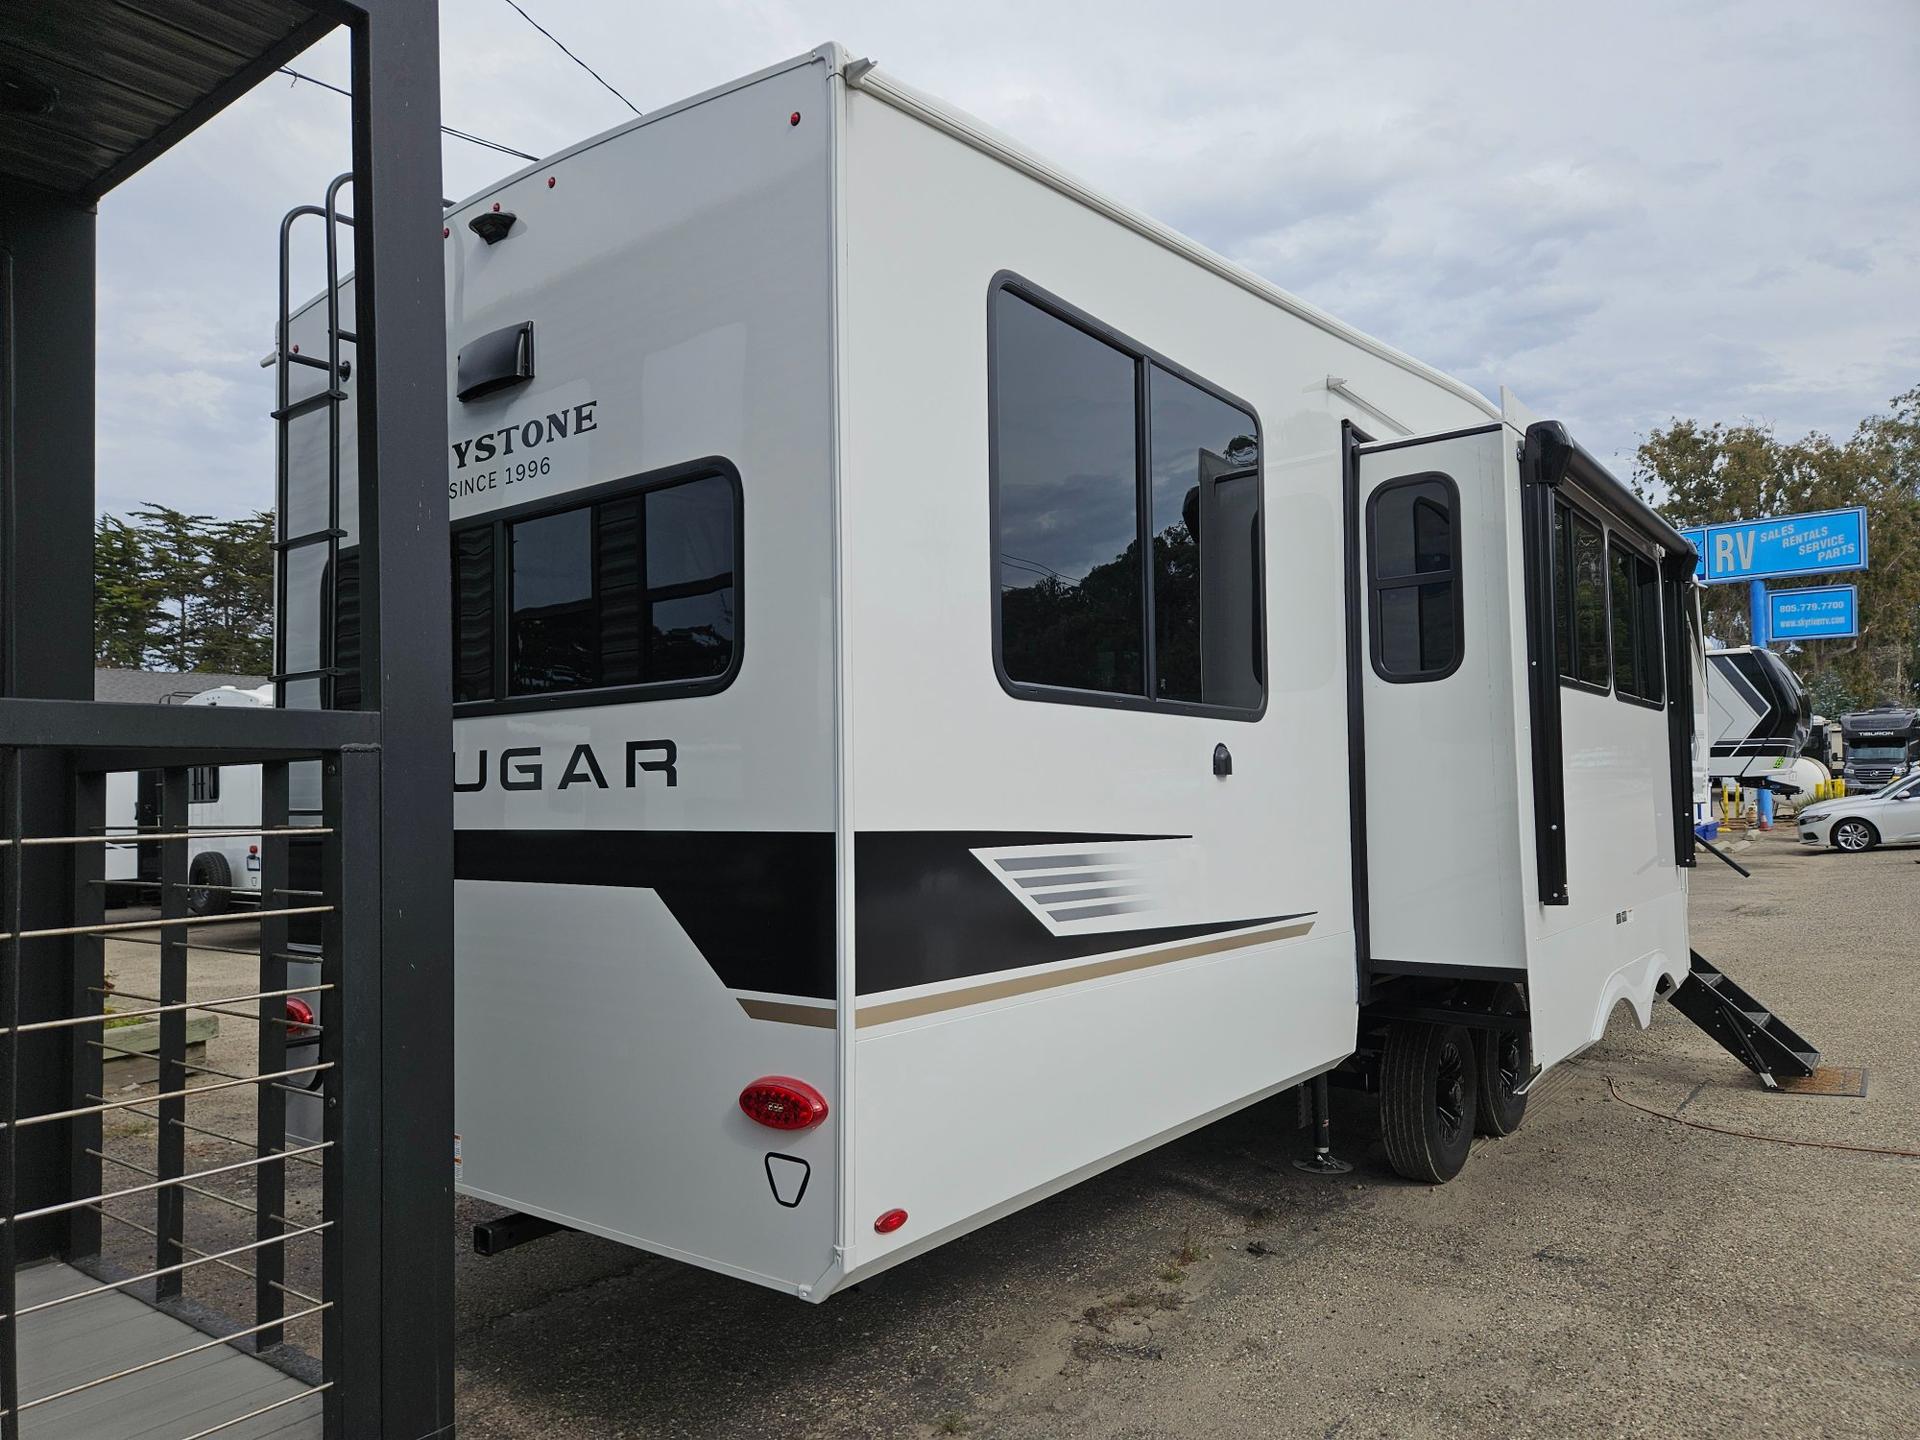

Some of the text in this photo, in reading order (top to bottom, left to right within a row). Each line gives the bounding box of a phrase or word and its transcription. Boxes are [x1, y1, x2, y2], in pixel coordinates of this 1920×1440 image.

[451, 400, 597, 469] YSTONE
[448, 456, 551, 499] SINCE 1996
[1760, 524, 1795, 543] SALES
[1782, 526, 1829, 549] RENTALS
[1798, 534, 1845, 556] SERVICE
[1715, 530, 1755, 573] RV
[1817, 543, 1855, 562] PARTS
[453, 739, 678, 792] UGAR
